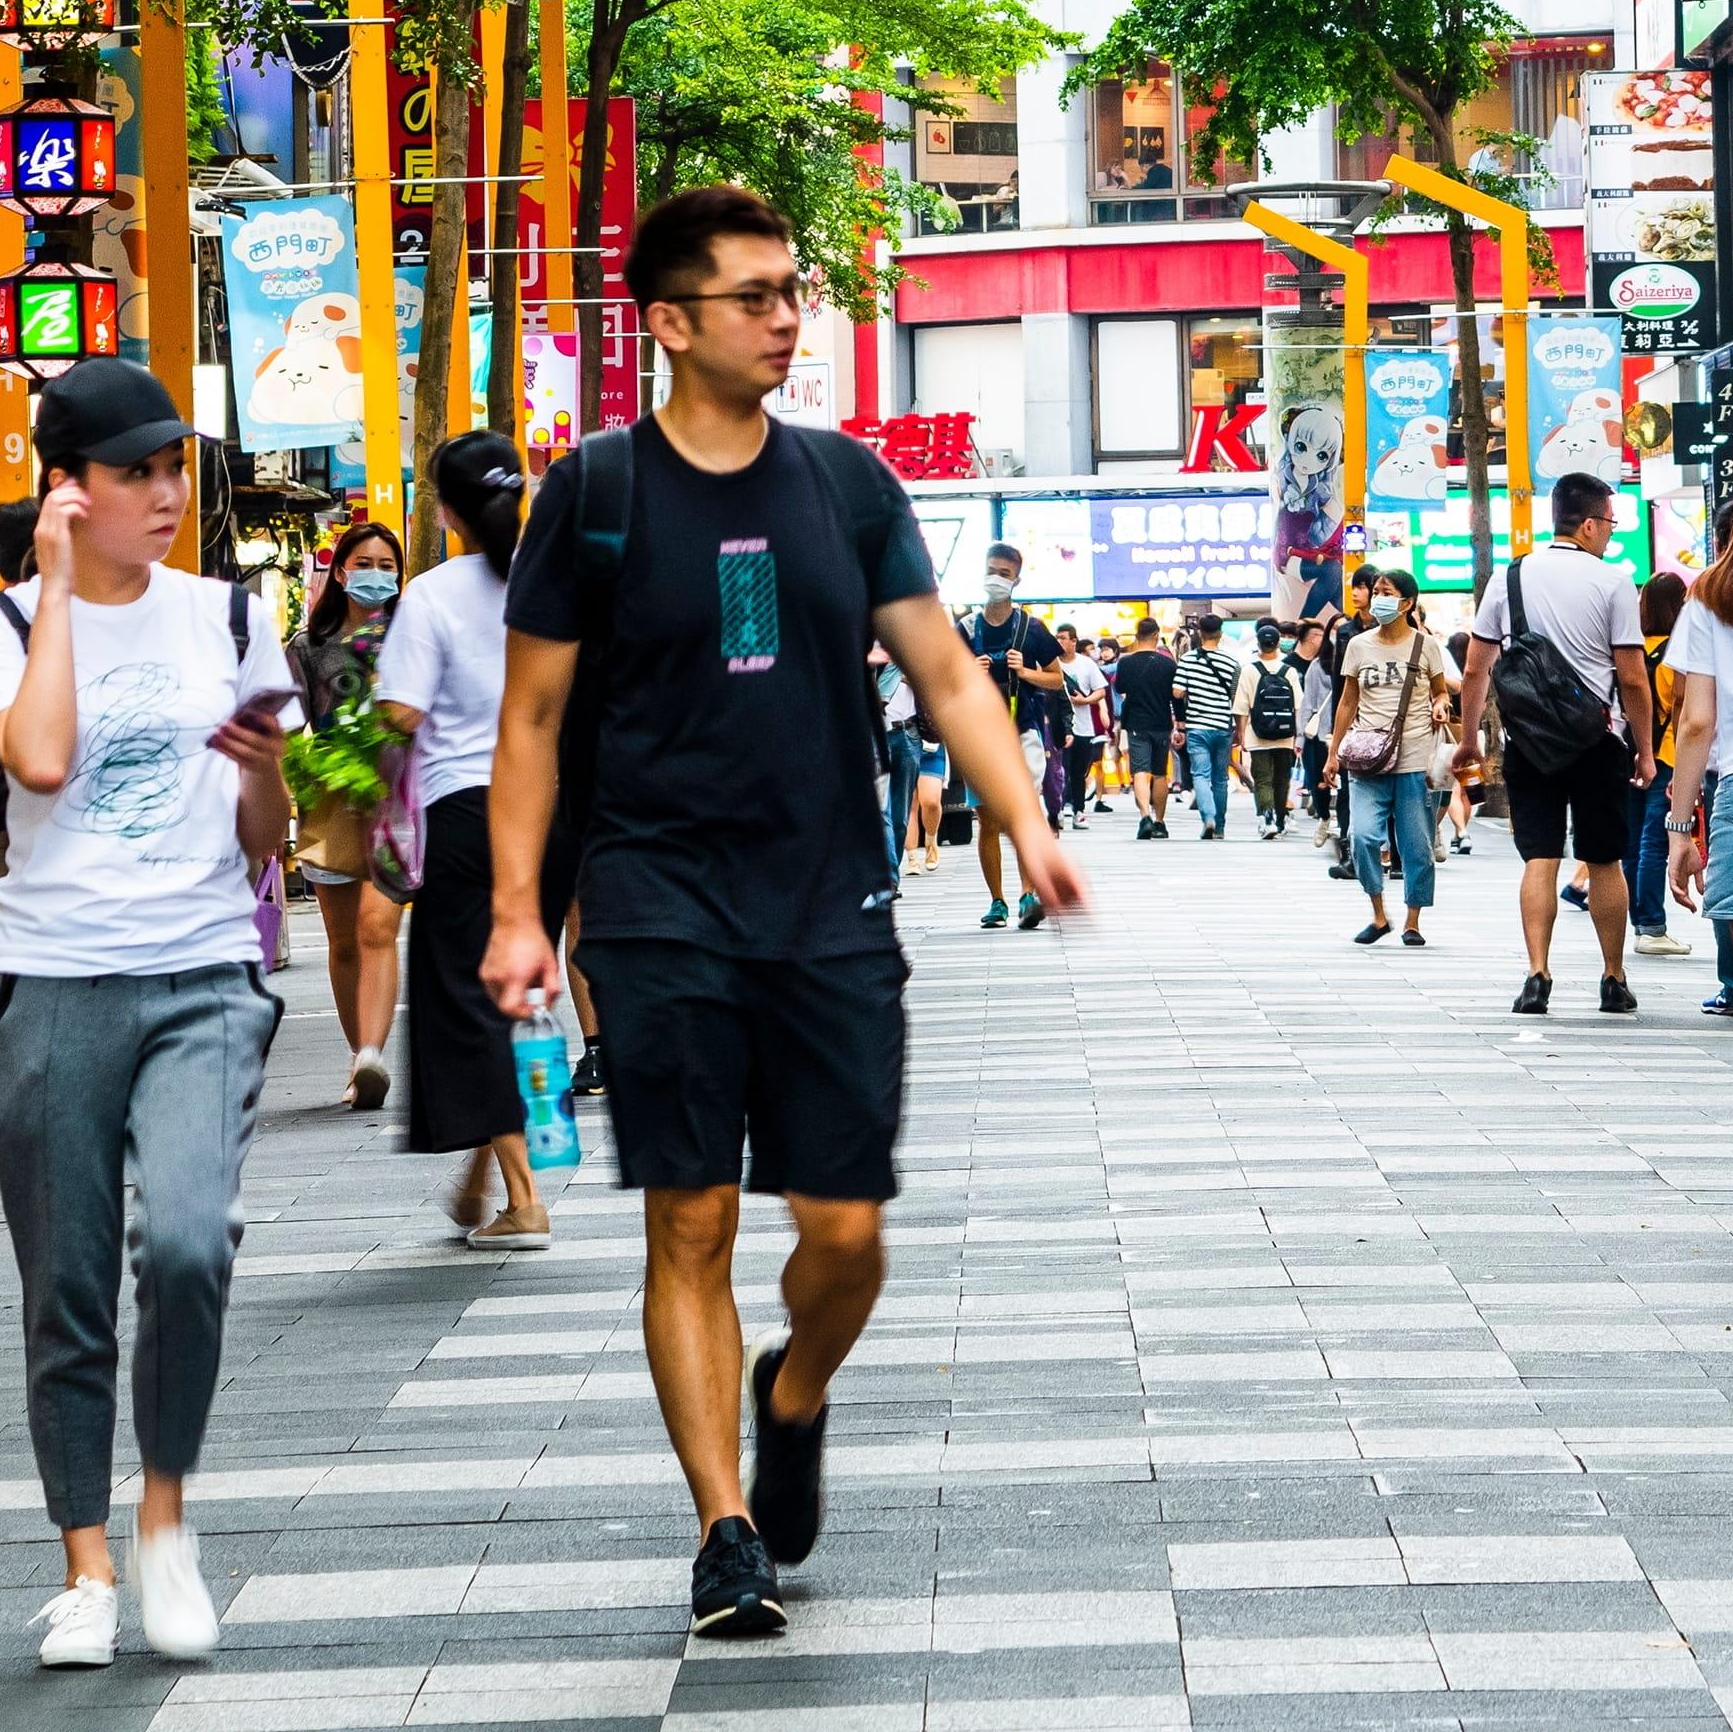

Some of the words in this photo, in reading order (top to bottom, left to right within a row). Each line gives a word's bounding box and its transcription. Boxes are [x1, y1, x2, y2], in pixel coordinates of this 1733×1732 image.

[248, 233, 332, 263] 西門町
[1618, 279, 1694, 305] Saizeriya
[1621, 321, 1676, 332] 大利料理
[1545, 344, 1605, 362] 西門町
[1380, 376, 1435, 393] 西門町
[602, 390, 624, 400] ore
[375, 484, 394, 506] H
[1515, 530, 1528, 545] H
